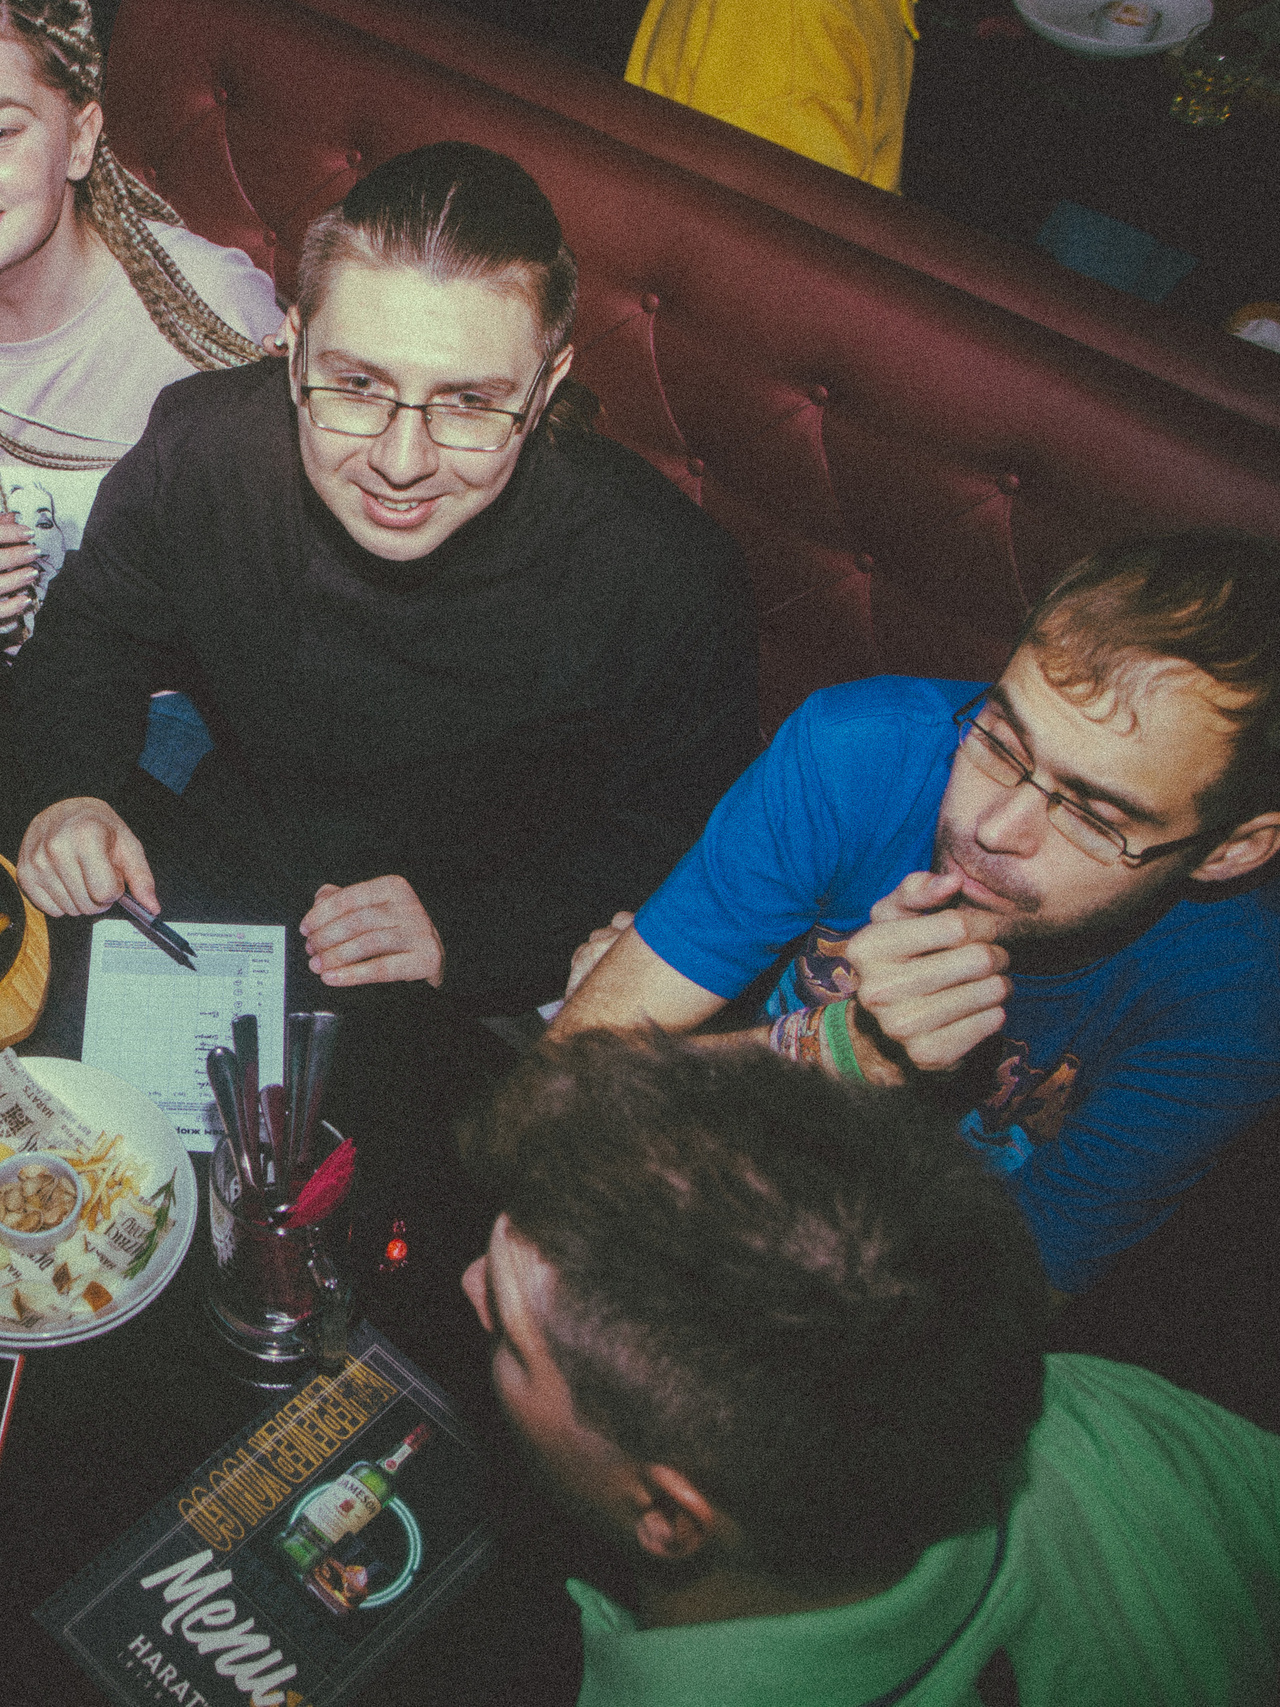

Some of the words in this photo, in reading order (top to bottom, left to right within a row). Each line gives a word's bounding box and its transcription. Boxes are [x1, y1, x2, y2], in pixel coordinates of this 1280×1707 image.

[179, 1487, 245, 1549] GO
[208, 1449, 292, 1526] YOU
[140, 1549, 298, 1707] Menu
